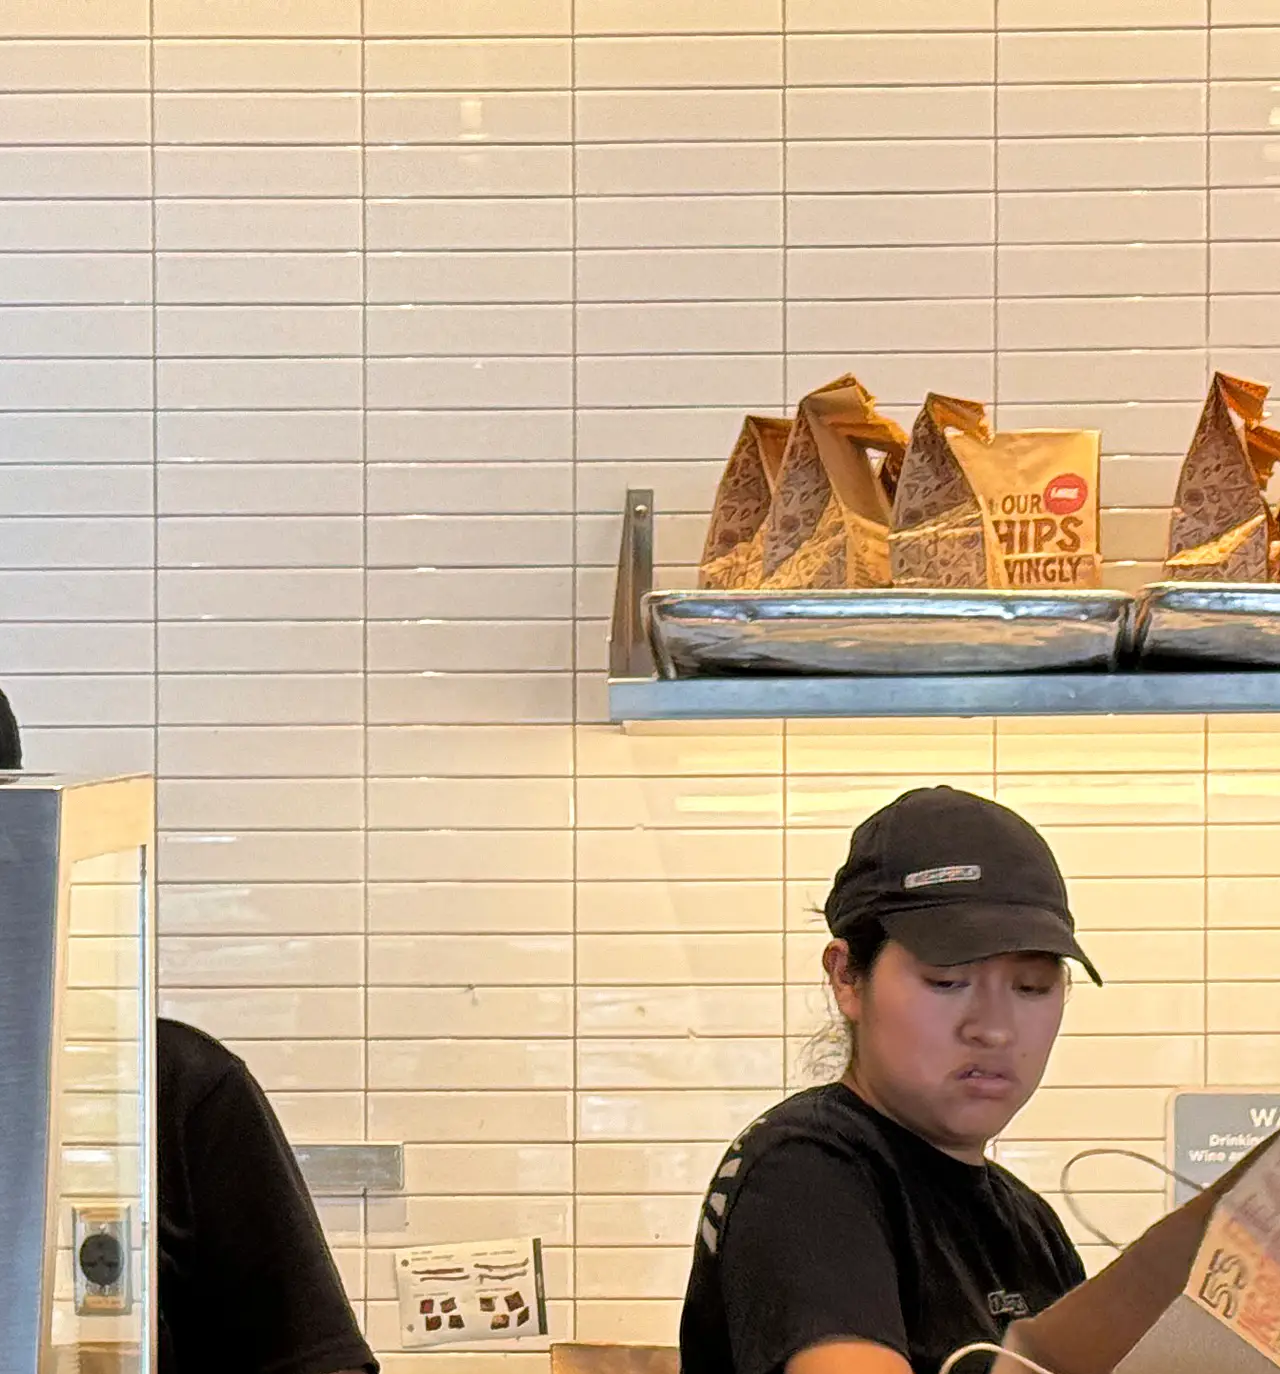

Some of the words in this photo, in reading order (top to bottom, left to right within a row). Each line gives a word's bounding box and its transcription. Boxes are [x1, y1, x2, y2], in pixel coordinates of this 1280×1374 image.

[1001, 493, 1042, 514] OUR
[991, 516, 1084, 555] HIPS
[1004, 556, 1081, 584] VINGLY
